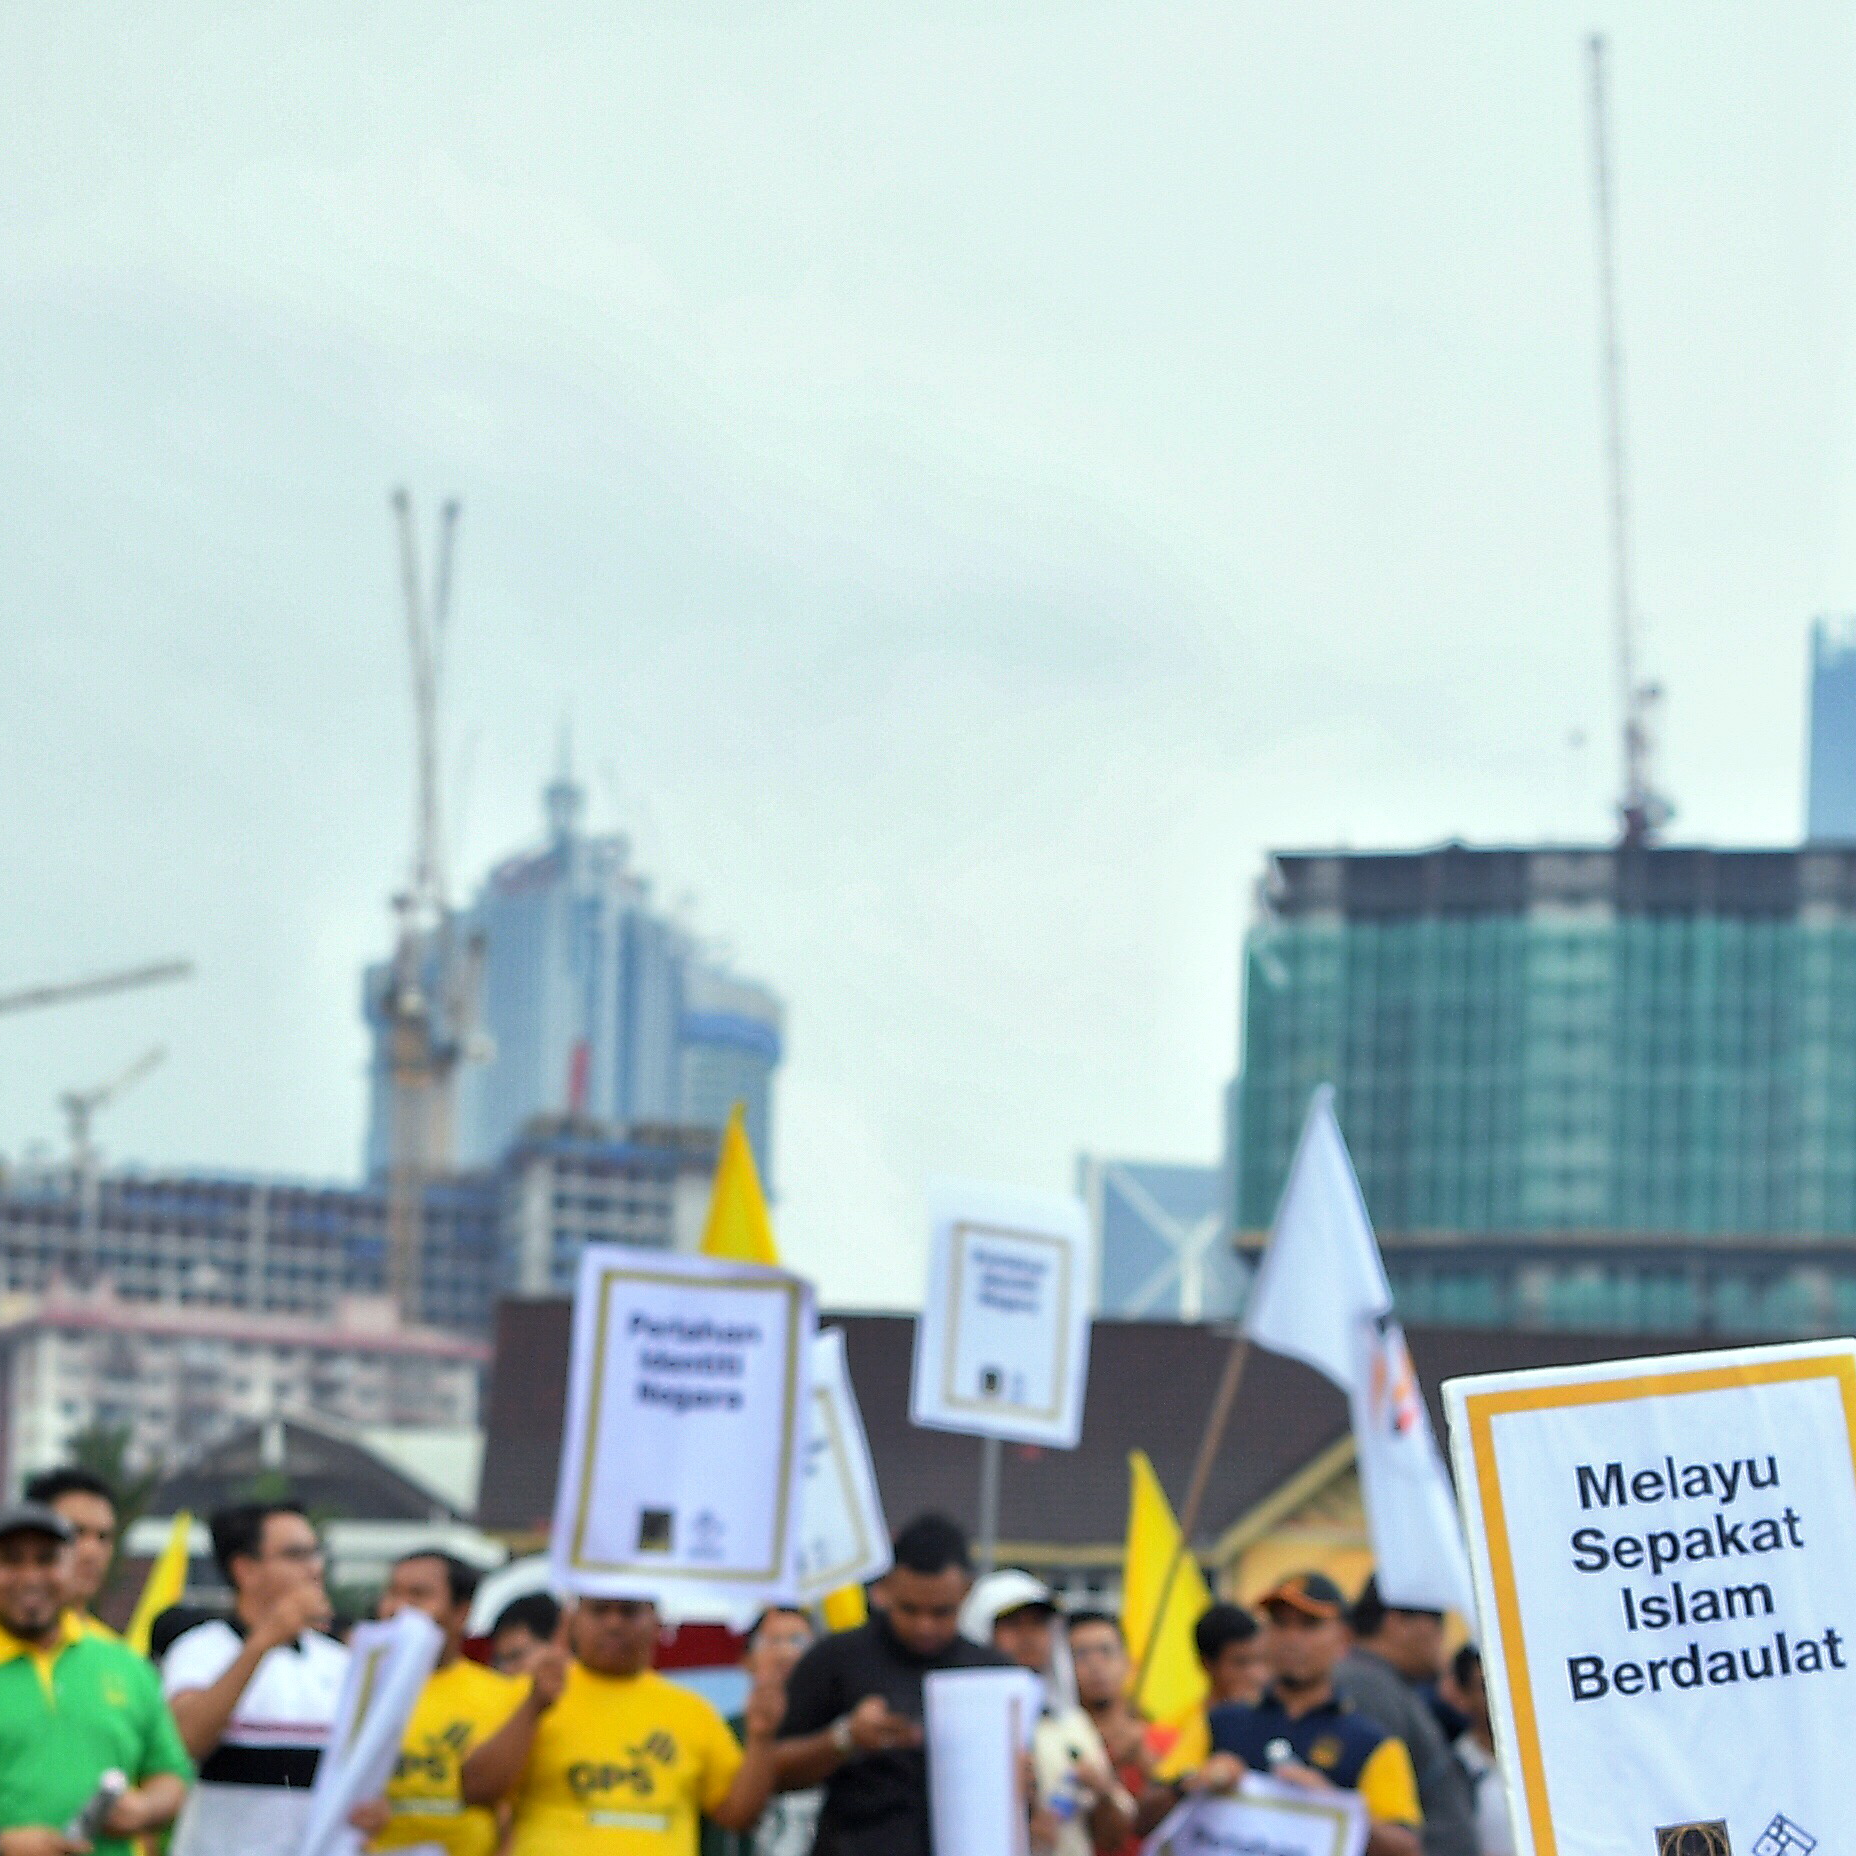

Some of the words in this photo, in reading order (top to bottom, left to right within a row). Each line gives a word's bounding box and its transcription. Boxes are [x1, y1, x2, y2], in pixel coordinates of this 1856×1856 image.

[1576, 1455, 1780, 1509] Melayu
[1570, 1508, 1804, 1575] Sepakat
[1621, 1581, 1775, 1631] Islam
[1566, 1628, 1846, 1701] Berdaulat
